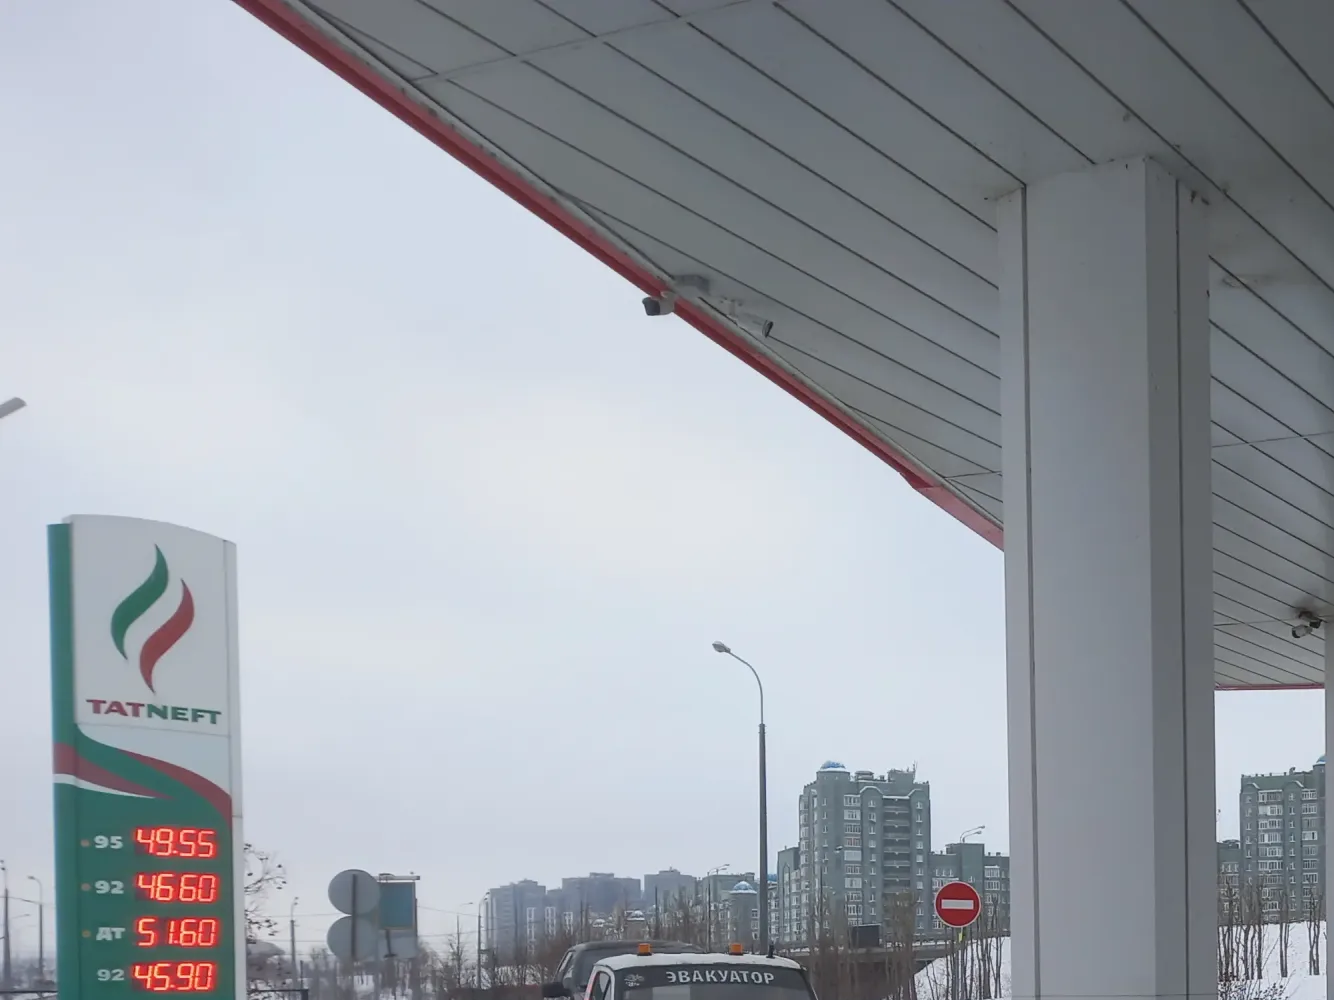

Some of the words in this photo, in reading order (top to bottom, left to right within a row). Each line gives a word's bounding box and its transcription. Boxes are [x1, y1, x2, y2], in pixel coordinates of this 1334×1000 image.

[86, 699, 222, 725] TATNEFT
[94, 835, 124, 849] 95
[136, 828, 216, 858] 49.55
[95, 880, 125, 895] 92
[96, 926, 126, 941] ДТ
[137, 918, 217, 947] 51.60
[97, 968, 125, 982] 92
[134, 963, 213, 991] 45.90
[665, 970, 775, 985] ЭВАКУАТОР
